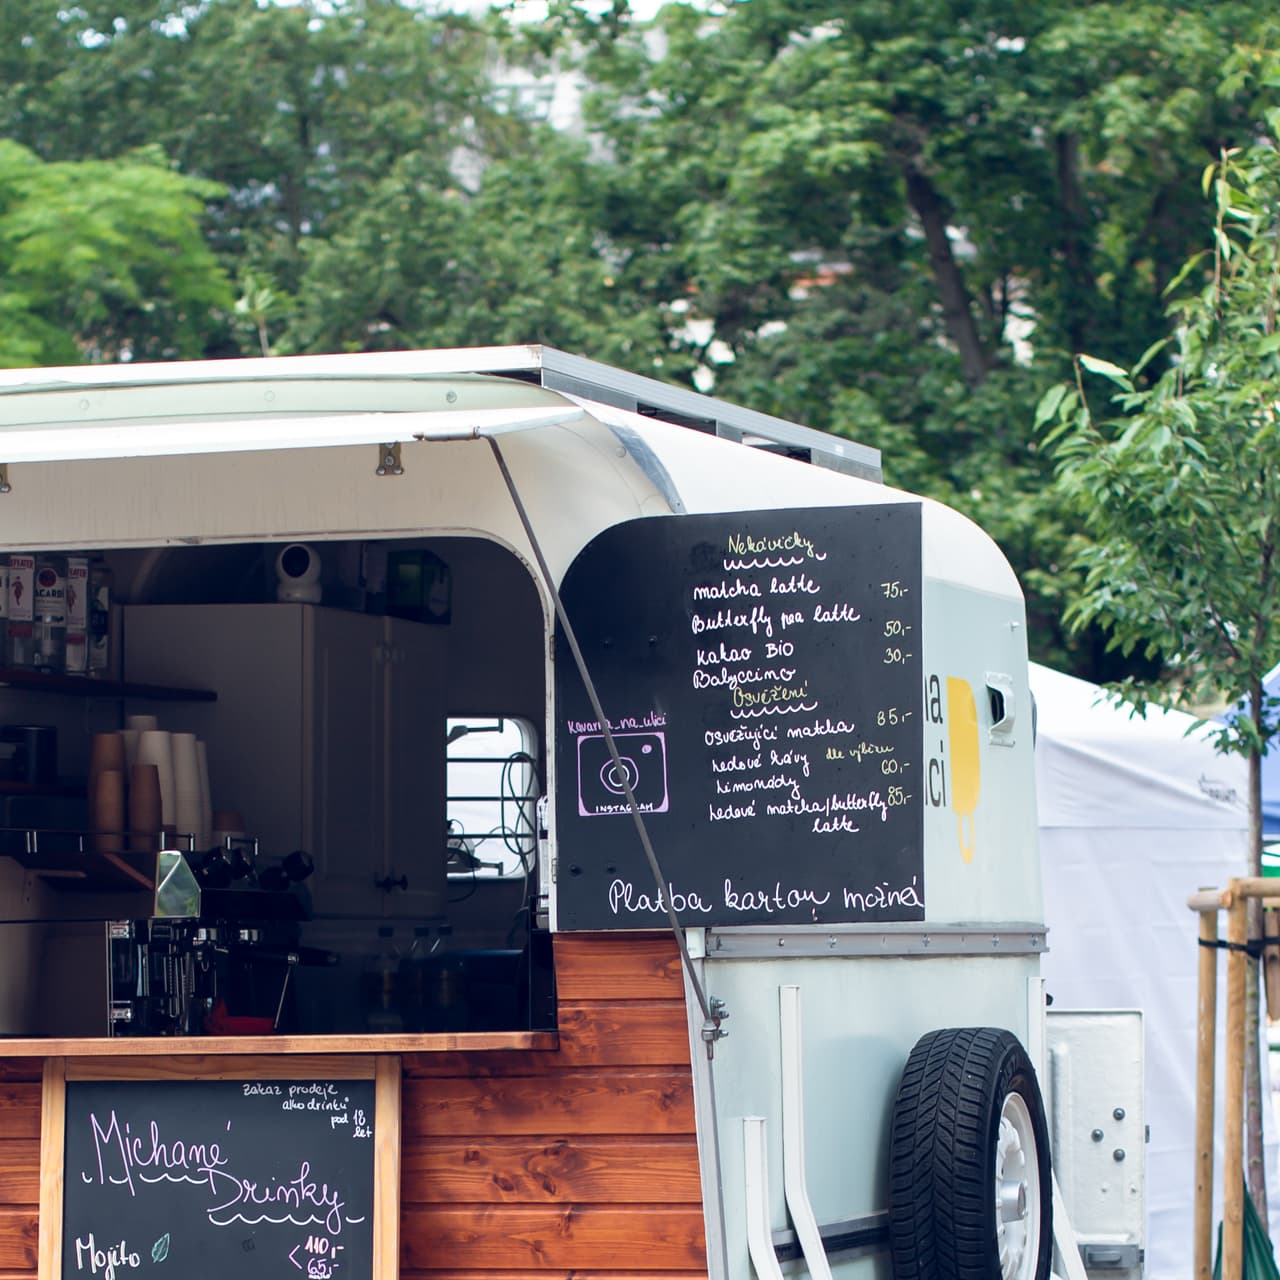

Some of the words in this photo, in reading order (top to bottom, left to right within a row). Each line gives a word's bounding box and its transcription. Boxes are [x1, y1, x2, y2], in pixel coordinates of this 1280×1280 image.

[693, 578, 762, 600] matcha
[770, 573, 821, 594] latte
[691, 605, 772, 637] Butterfly
[813, 603, 861, 623] latte
[787, 719, 855, 738] matcha
[596, 802, 654, 813] INSTAGAM
[812, 817, 860, 833] latte
[608, 879, 713, 914] Platba
[723, 878, 830, 913] kartou
[288, 1083, 338, 1100] prodeje
[330, 1113, 349, 1129] pod
[352, 1109, 367, 1126] 18
[353, 1125, 372, 1138] let
[197, 1161, 345, 1235] Drinky
